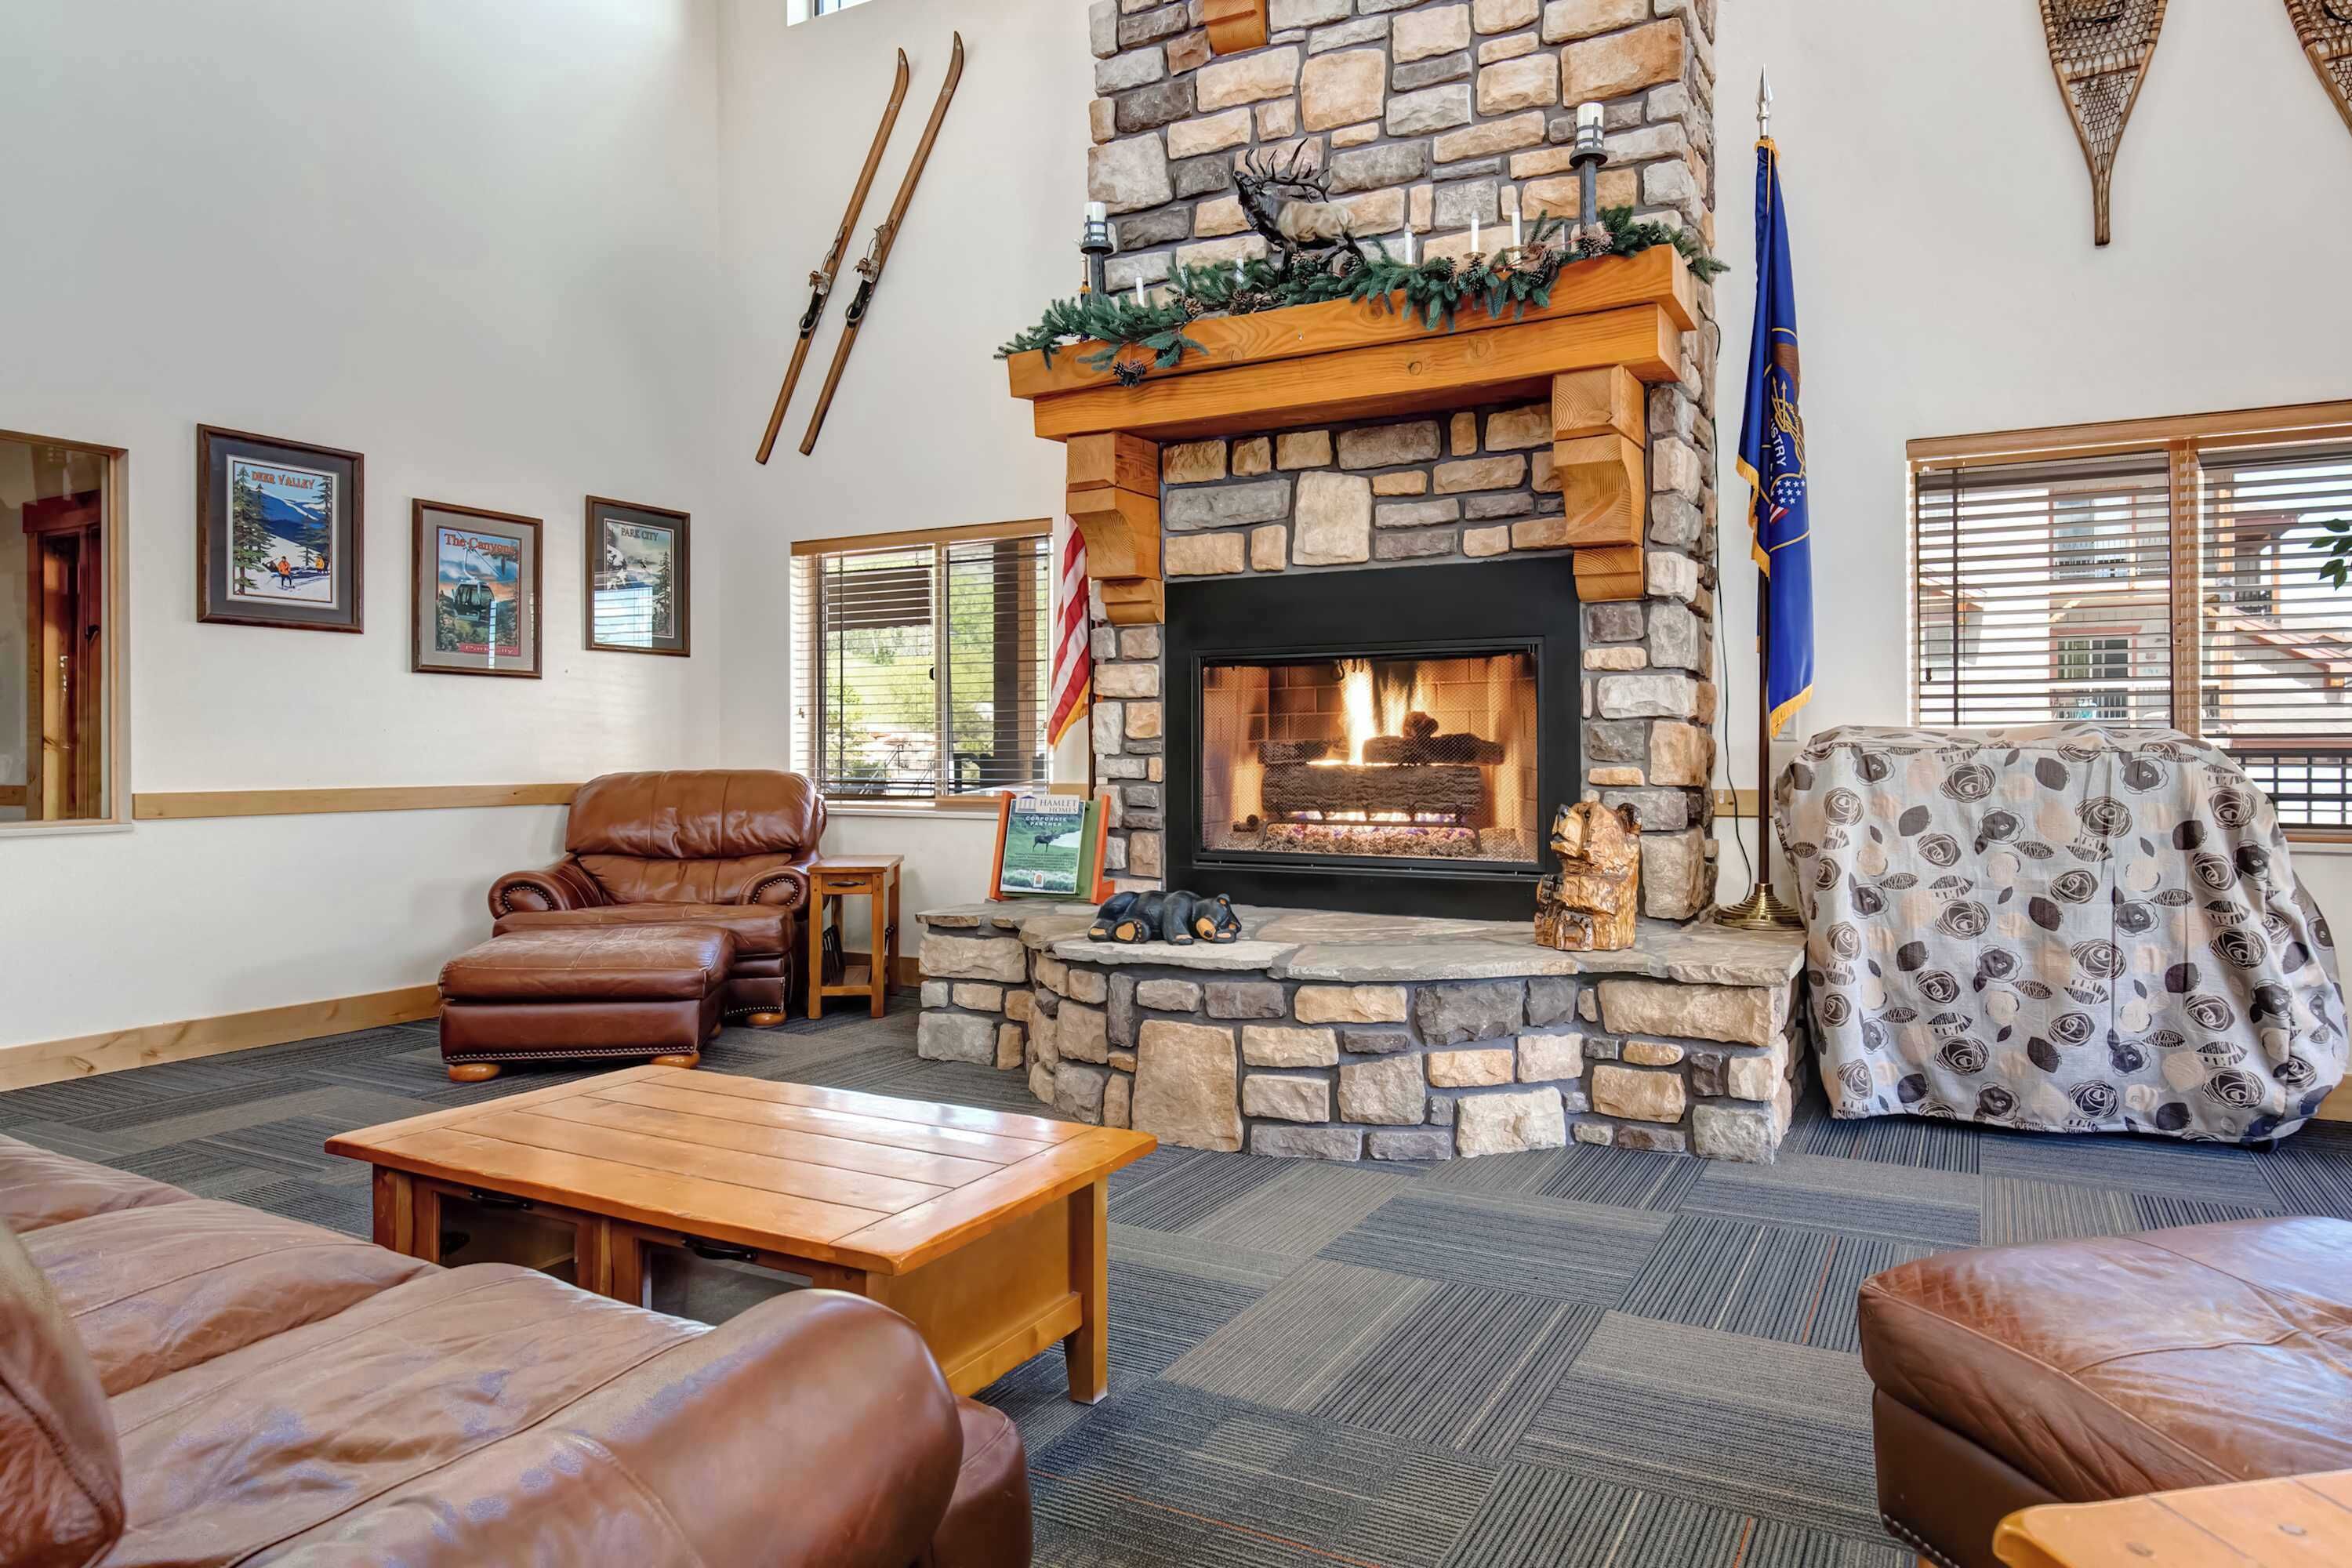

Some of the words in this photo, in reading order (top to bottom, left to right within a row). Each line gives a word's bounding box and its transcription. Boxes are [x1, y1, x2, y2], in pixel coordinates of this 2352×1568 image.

[1770, 418, 1787, 466] STRY
[252, 471, 275, 485] DEER
[278, 474, 315, 489] VALLEY
[445, 533, 466, 547] The
[621, 527, 641, 539] PARK
[641, 531, 659, 541] CITY
